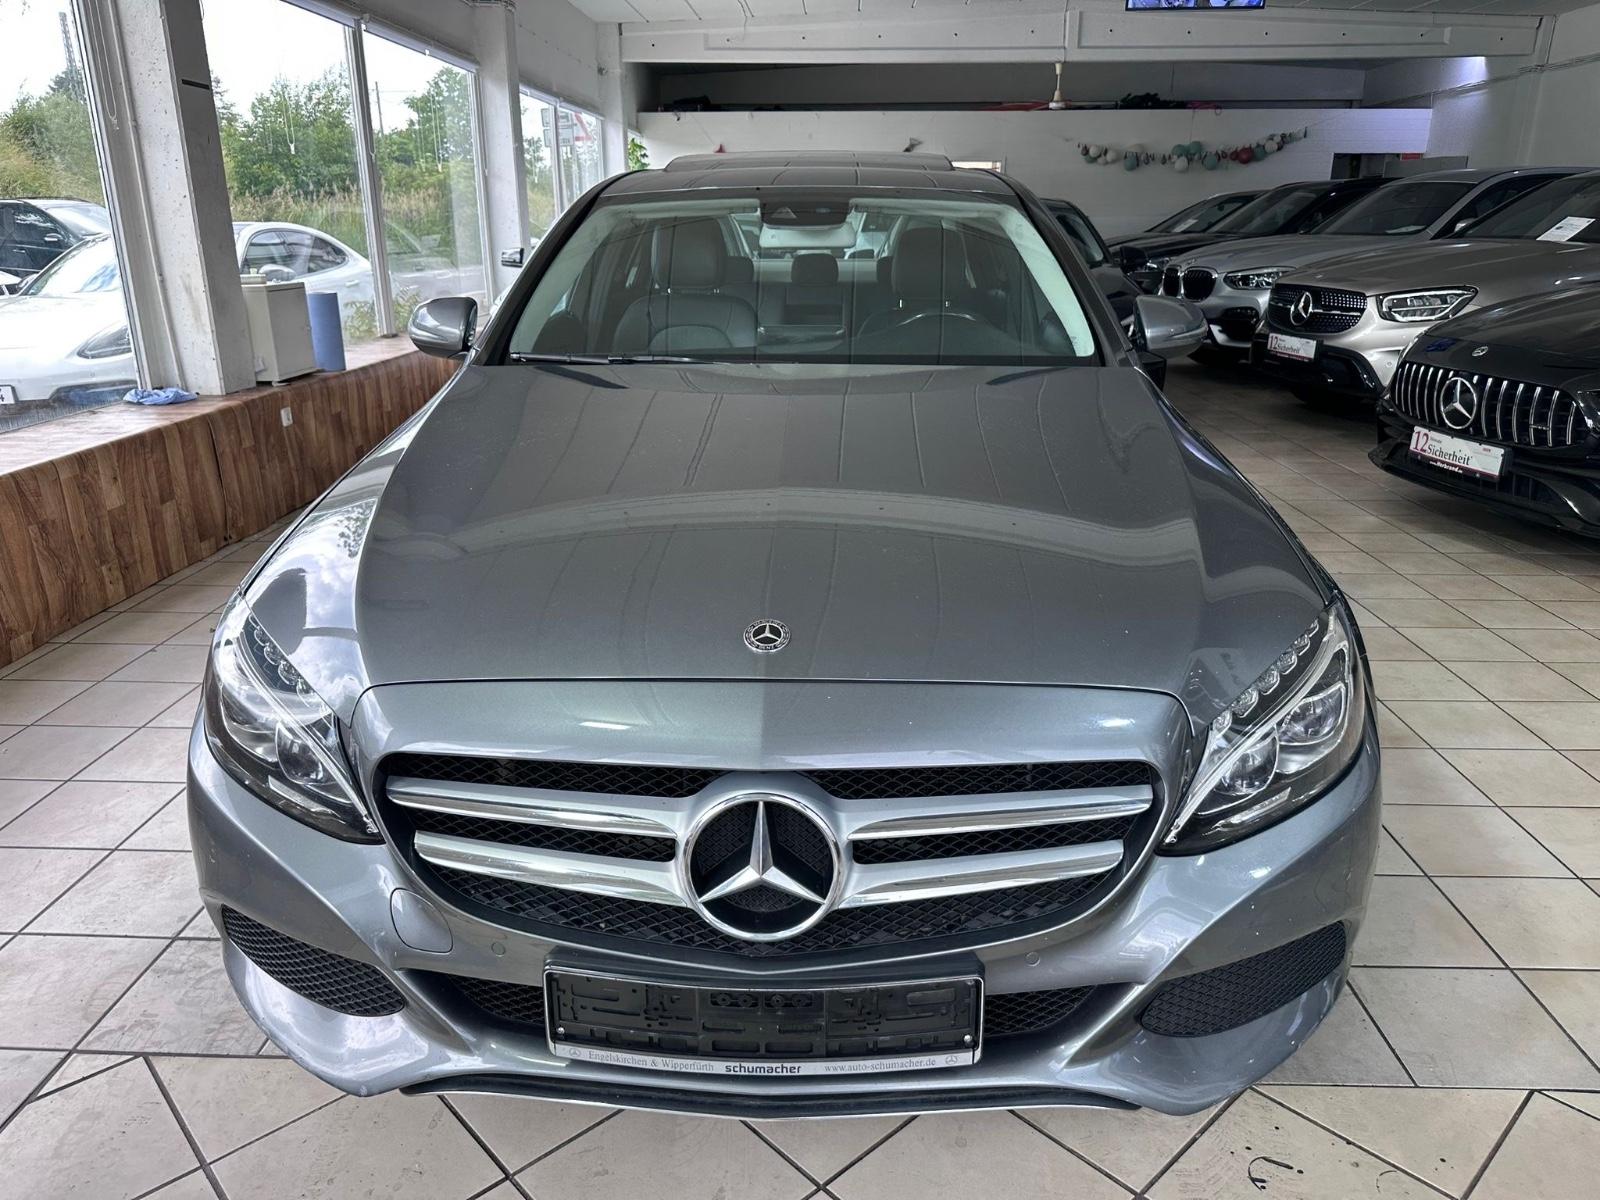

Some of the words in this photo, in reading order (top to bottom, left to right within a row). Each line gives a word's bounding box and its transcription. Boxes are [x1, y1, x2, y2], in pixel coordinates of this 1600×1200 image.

[1413, 431, 1430, 452] 12
[588, 1050, 648, 1067] Engelskirchen
[650, 1058, 659, 1067] &
[725, 1064, 801, 1074] schumacher
[824, 1058, 936, 1072] www.auto-schumacher.de
